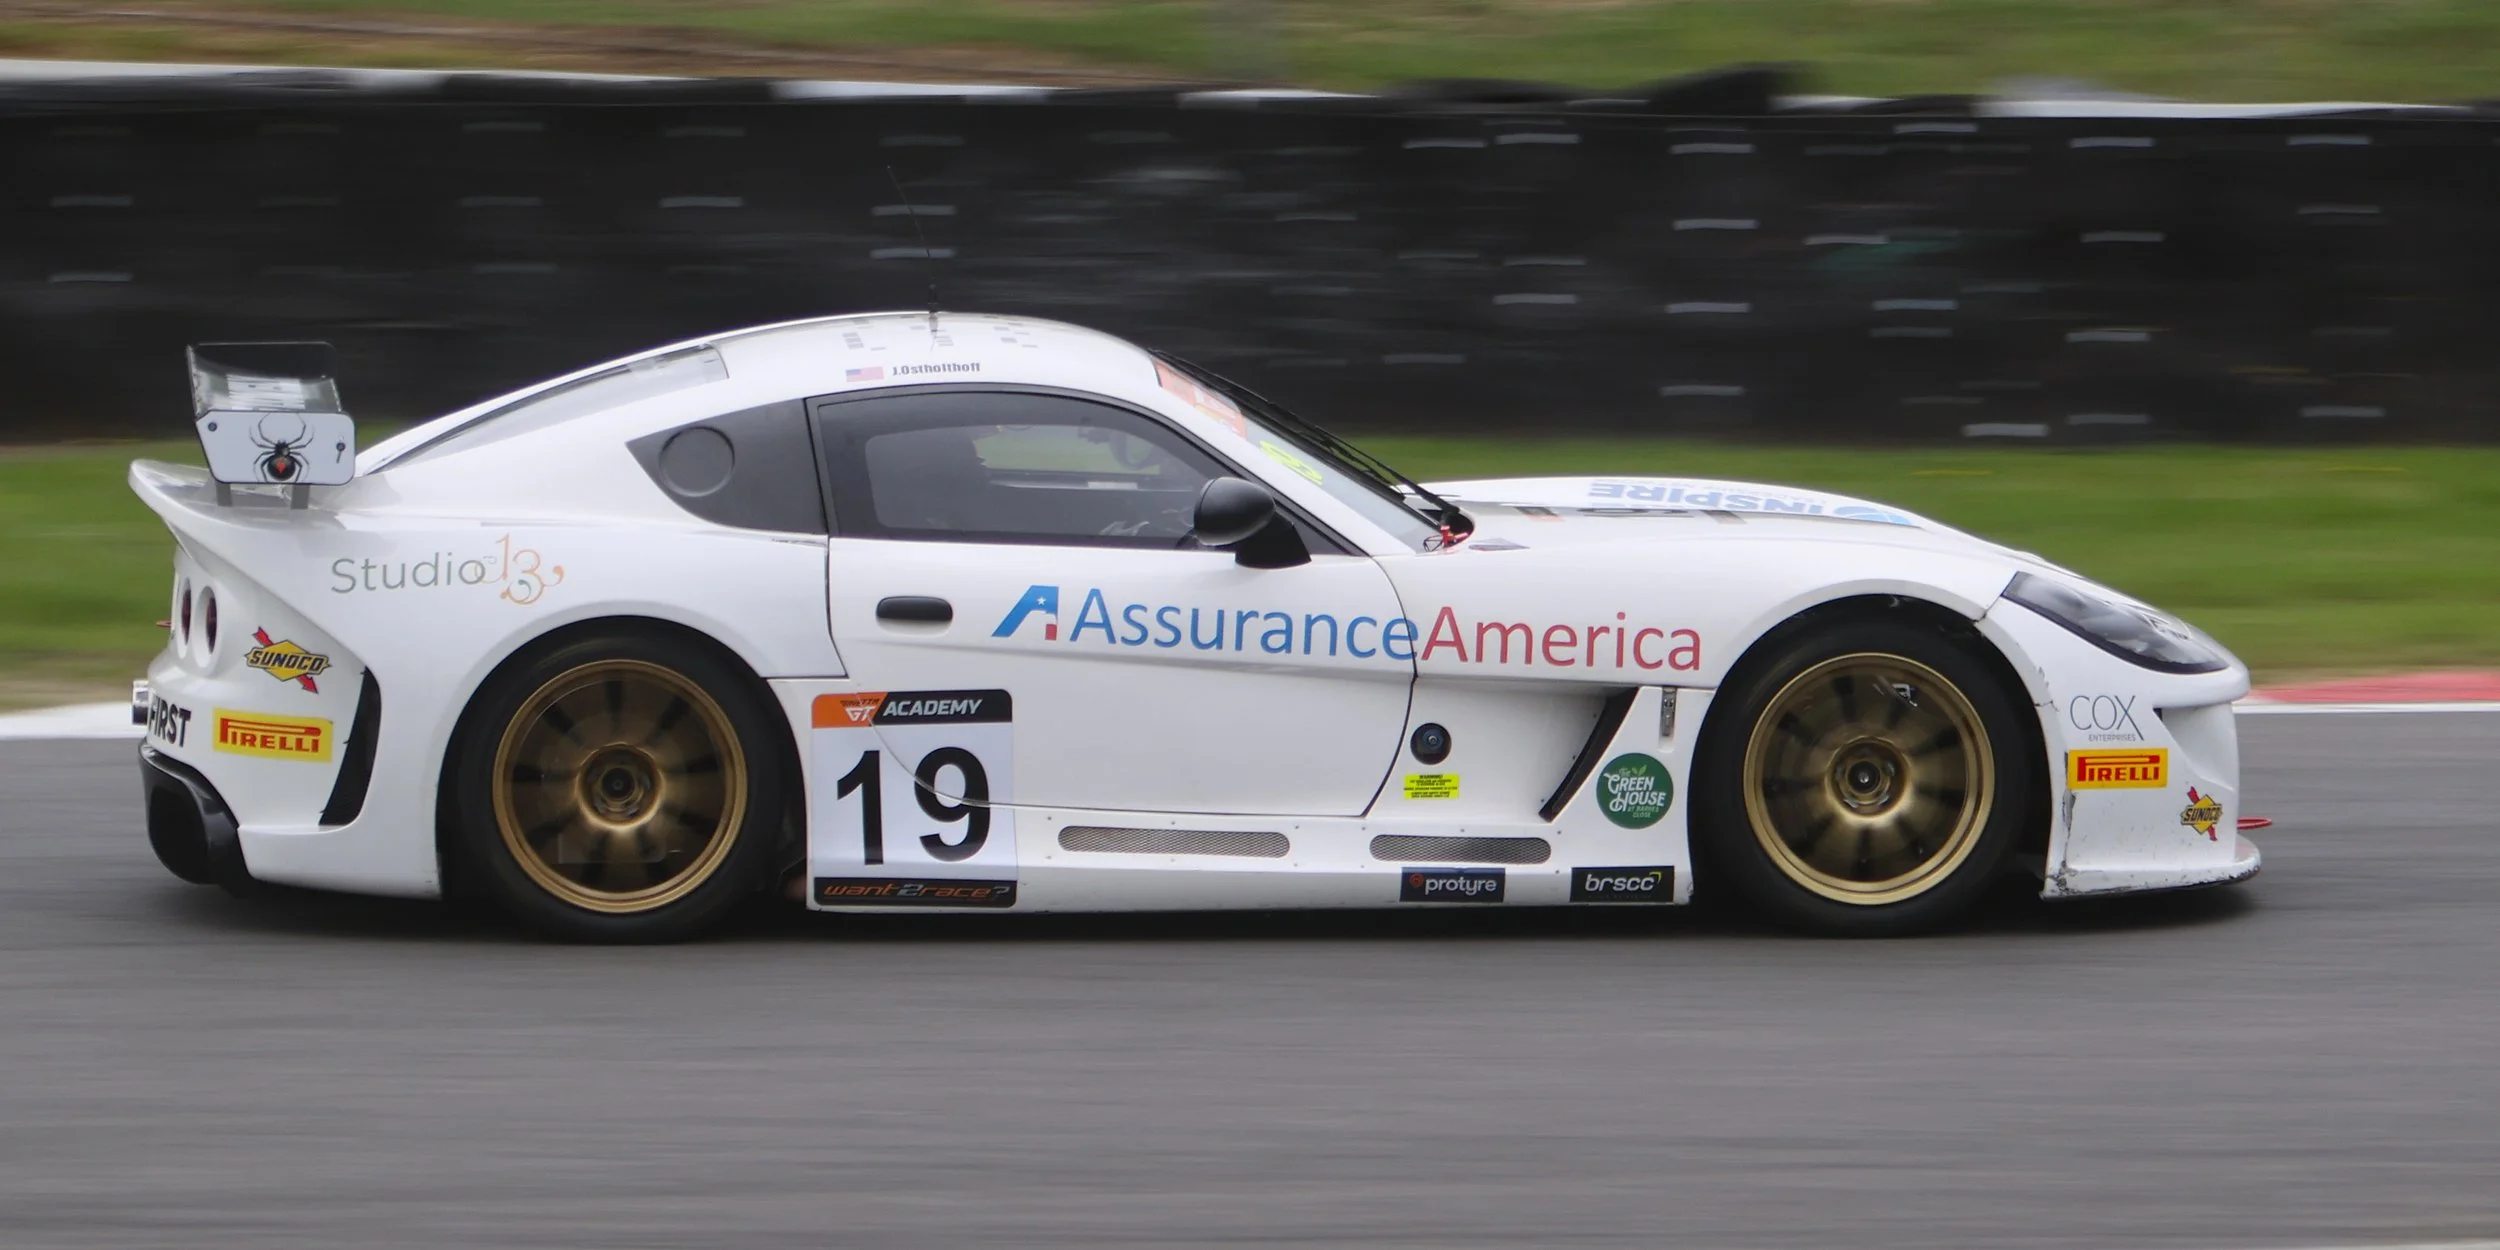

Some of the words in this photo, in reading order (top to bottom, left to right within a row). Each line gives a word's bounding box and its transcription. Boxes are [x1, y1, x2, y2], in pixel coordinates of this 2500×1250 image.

[1589, 482, 1823, 515] INSPIRE
[331, 552, 485, 594] Studio
[1069, 587, 1702, 672] AssuranceAmerica
[249, 650, 326, 673] SUNOCO
[845, 705, 877, 722] GT
[882, 698, 983, 717] ACADEMY
[2069, 694, 2145, 741] COX
[219, 717, 322, 753] PIRELLI
[2077, 755, 2160, 782] PIRELLI
[836, 746, 991, 866] 19
[2183, 806, 2222, 823] SUNOCO
[823, 882, 1011, 901] want2race?
[1424, 876, 1498, 896] protyre
[1584, 873, 1655, 892] brscc
